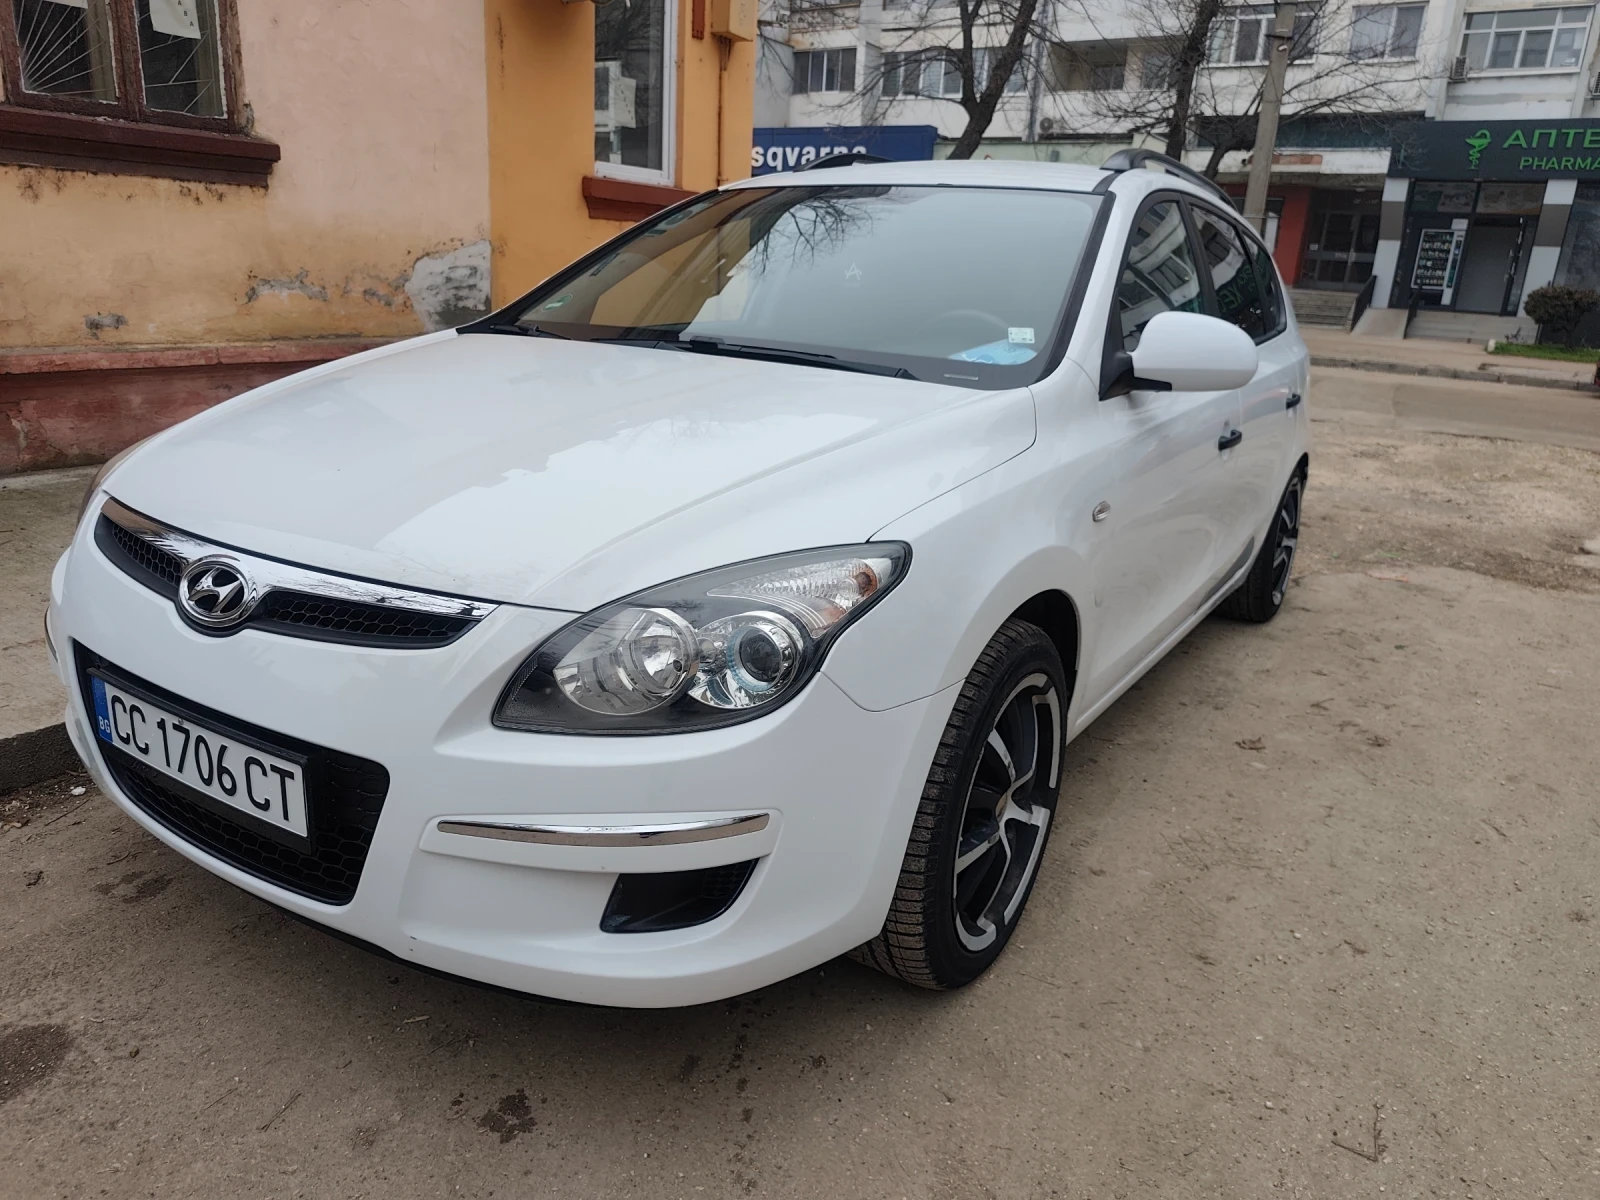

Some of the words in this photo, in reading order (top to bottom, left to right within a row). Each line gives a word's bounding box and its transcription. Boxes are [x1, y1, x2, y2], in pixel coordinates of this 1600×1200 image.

[1502, 128, 1600, 149] АПТЕ
[98, 715, 111, 734] BG
[111, 694, 149, 755] CC
[156, 717, 237, 797] 1706
[244, 755, 295, 821] CT
